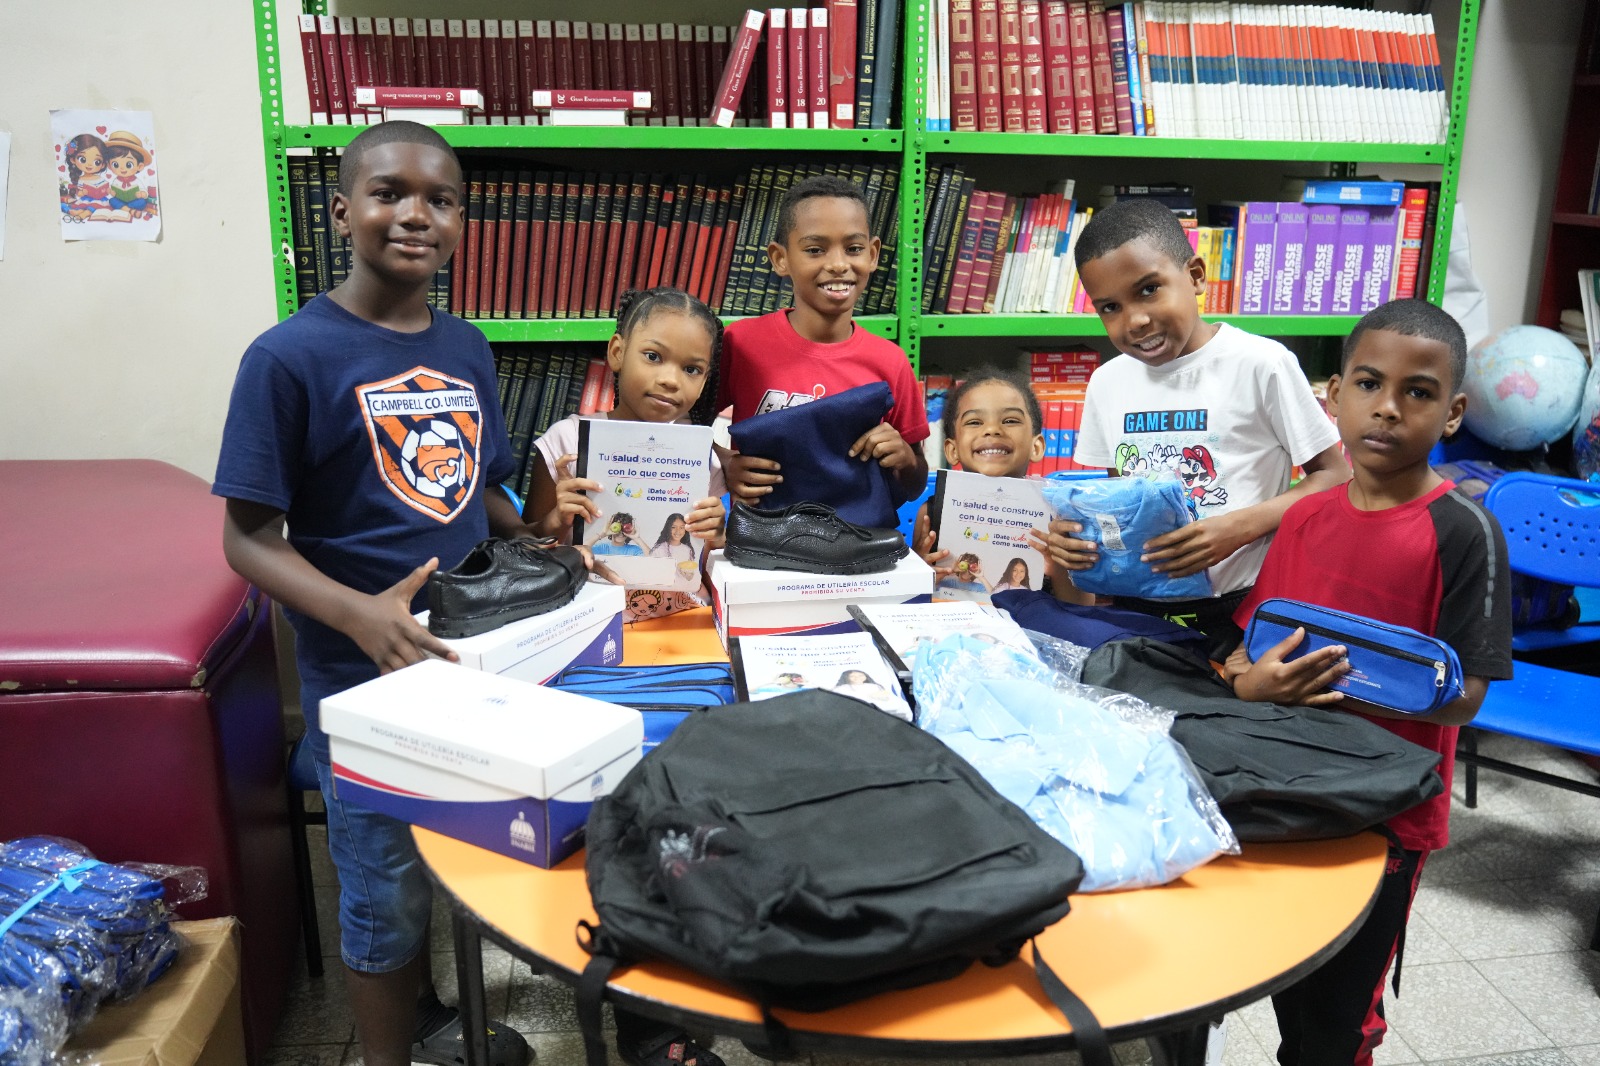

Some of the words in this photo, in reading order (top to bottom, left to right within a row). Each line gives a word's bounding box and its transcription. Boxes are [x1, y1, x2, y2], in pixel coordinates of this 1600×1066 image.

[864, 65, 870, 74] 8
[334, 100, 342, 108] 16
[775, 98, 784, 106] 19
[817, 98, 826, 106] 20
[938, 173, 950, 199] SALVAT
[314, 214, 320, 222] 8
[301, 256, 308, 265] 9
[334, 257, 341, 266] 6
[733, 254, 742, 264] 11
[744, 254, 754, 264] 10
[762, 255, 768, 264] 9
[882, 254, 888, 263] 3
[934, 255, 940, 264] 1
[1264, 243, 1272, 280] ILUSTRADO
[1294, 243, 1303, 280] ILUSTRADO
[1324, 244, 1334, 281] ILUSTRADO
[1354, 244, 1364, 281] ILUSTRADO
[1382, 244, 1392, 281] ILUSTRADO
[1244, 270, 1253, 302] PEQUEÑO
[1251, 243, 1266, 312] LAROUSSE
[1275, 270, 1284, 302] PEQUEÑO
[1281, 243, 1296, 311] LAROUSSE
[1304, 270, 1314, 302] PEQUEÑO
[1310, 244, 1327, 312] LAROUSSE
[1333, 270, 1343, 303] PEQUEÑO
[1340, 244, 1357, 312] LAROUSSE
[1362, 270, 1371, 303] PEQUEÑO
[1368, 244, 1385, 311] LAROUSSE
[372, 399, 423, 411] CAMPBELL
[425, 397, 443, 408] CO.
[444, 395, 475, 407] UNITED
[1126, 412, 1169, 432] GAME
[1173, 410, 1204, 429] ON!
[613, 455, 639, 463] salud
[655, 457, 702, 467] construye
[640, 470, 657, 479] que
[964, 501, 987, 510] salud
[1002, 506, 1044, 517] construye
[987, 517, 1003, 525] que
[1006, 519, 1033, 528] comes
[516, 632, 545, 648] PROGRAMA
[553, 618, 574, 631] UTILERÍA
[574, 607, 595, 621] ESCOLAR
[371, 726, 408, 741] PROGRAMA
[411, 737, 419, 745] DE
[422, 740, 454, 755] UTILERÍA
[456, 751, 490, 766] ESCOLAR
